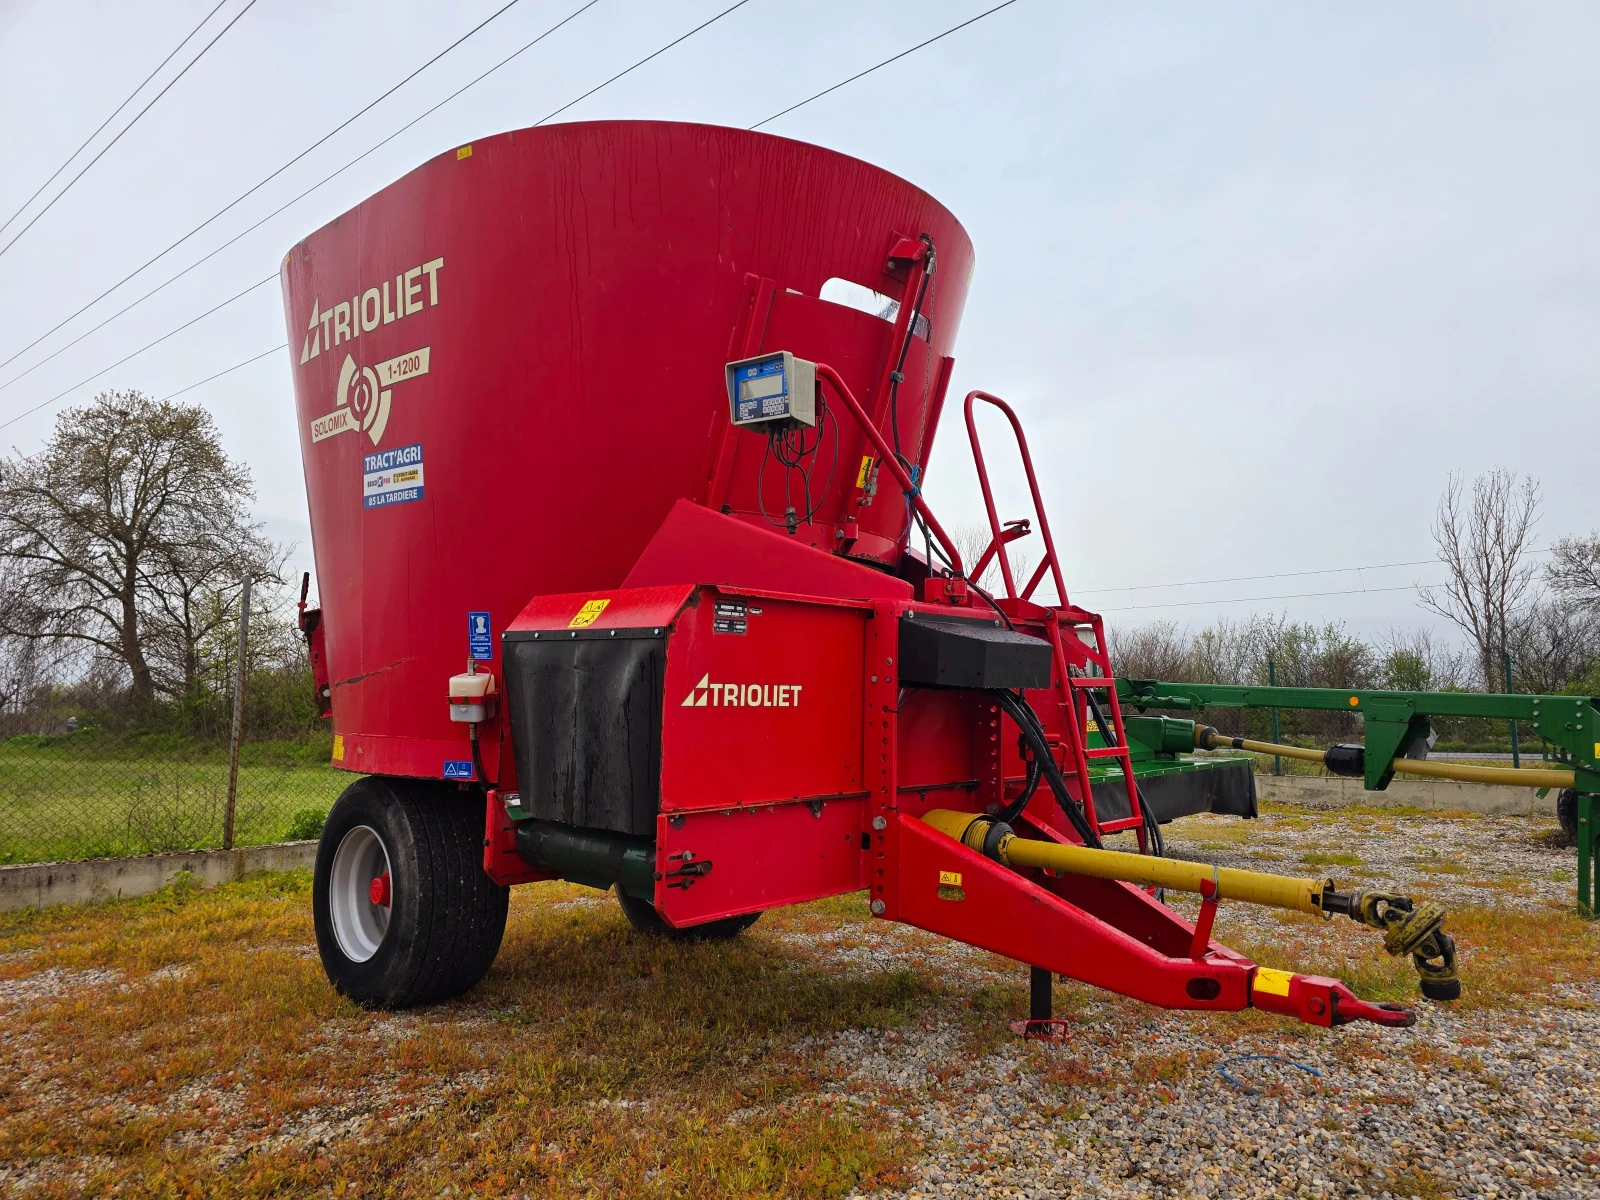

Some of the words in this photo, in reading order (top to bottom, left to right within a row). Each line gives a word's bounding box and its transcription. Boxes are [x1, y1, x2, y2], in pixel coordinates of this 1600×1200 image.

[319, 256, 444, 352] TRIOLIET
[387, 354, 420, 380] 1-1200
[314, 411, 348, 439] SOLOMIX
[364, 445, 421, 472] TRACT'AGRI
[368, 496, 376, 506] 85
[377, 494, 385, 505] LA
[386, 489, 418, 503] TARDIERE
[709, 683, 803, 707] TRIOLIET
